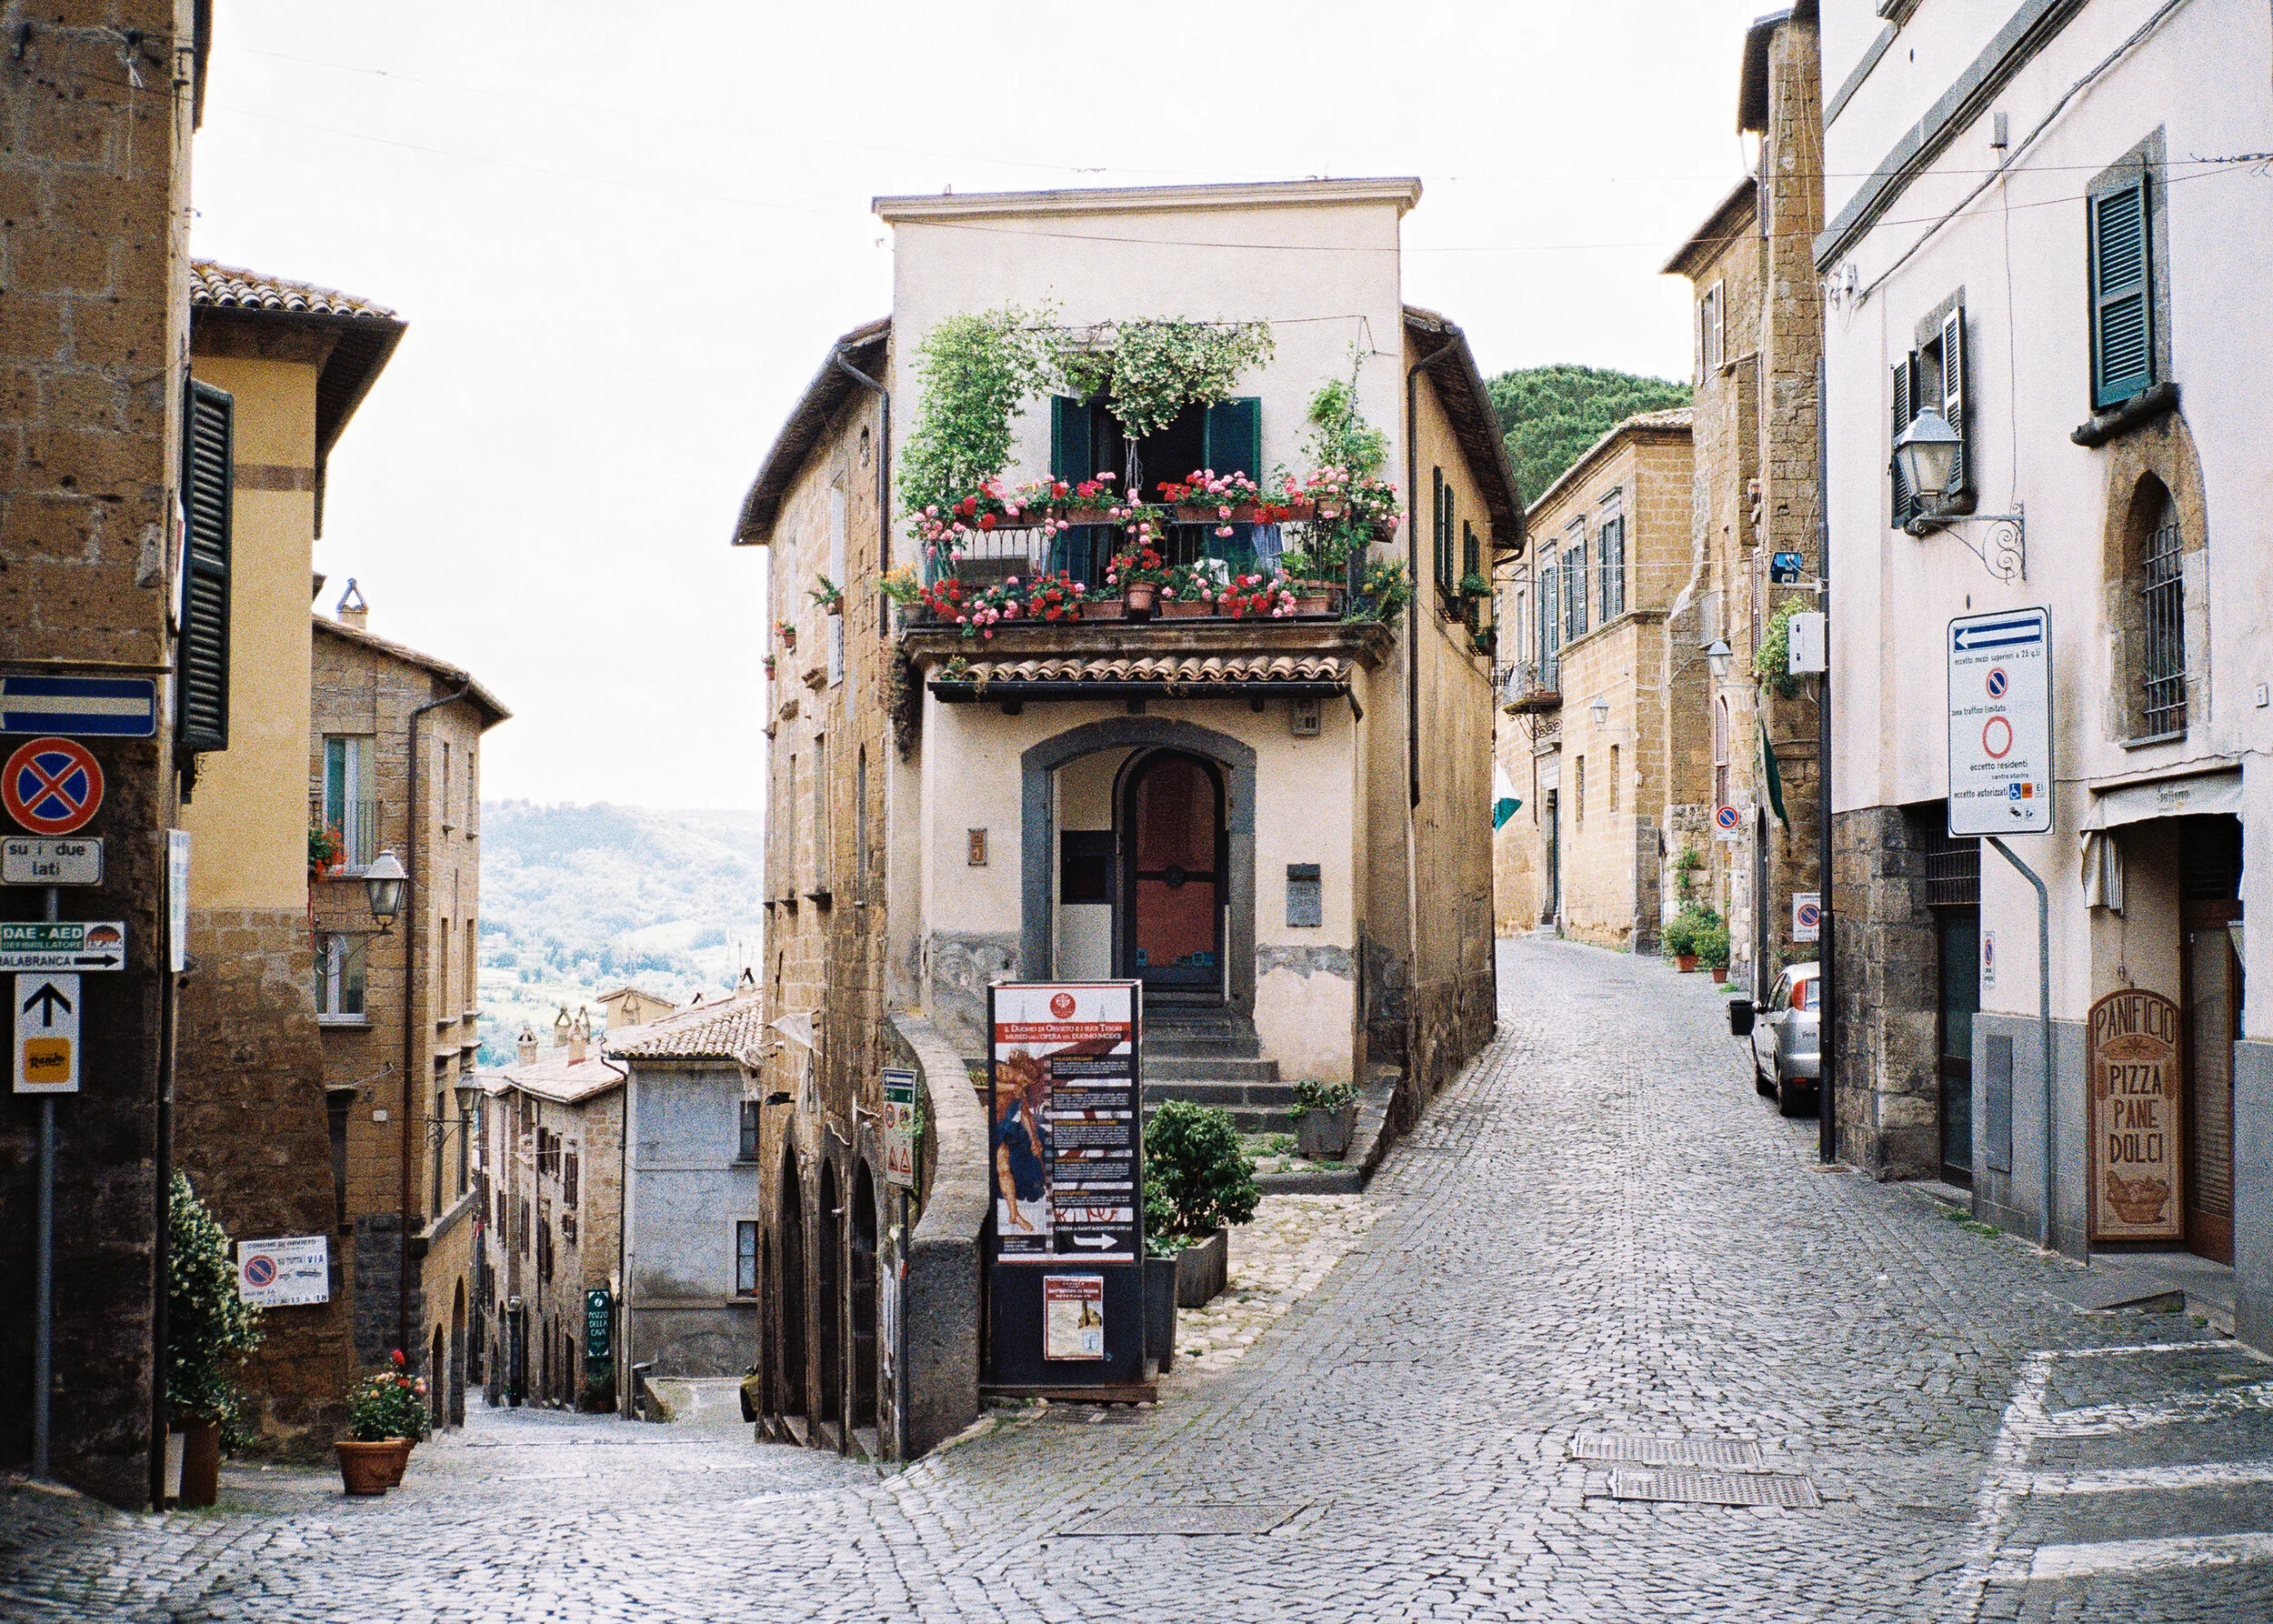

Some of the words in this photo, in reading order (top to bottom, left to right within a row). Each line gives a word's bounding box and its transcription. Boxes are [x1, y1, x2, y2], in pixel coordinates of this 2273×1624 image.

[1954, 657, 1973, 667] eccetto
[1991, 651, 2014, 663] superiori
[2021, 649, 2029, 658] 25
[1964, 706, 1984, 716] traffico
[1969, 762, 1995, 771] eccetto
[1997, 760, 2028, 769] residenti
[1954, 788, 1975, 798] eccetto
[1977, 786, 2008, 797] autorizzati
[9, 844, 27, 856] su
[37, 842, 42, 855] i
[56, 842, 85, 856] due
[33, 861, 60, 875] lati
[4, 927, 36, 939] DAE
[47, 927, 83, 939] AED
[3, 941, 83, 949] DEFIBRILLATORE
[2095, 996, 2176, 1048] PANIFICIO
[2109, 1064, 2162, 1095] PIZZA
[2114, 1098, 2158, 1129] PANE
[2110, 1133, 2164, 1164] DOLCI
[247, 1241, 276, 1249] COMUNE
[590, 1328, 606, 1337] CAVA
